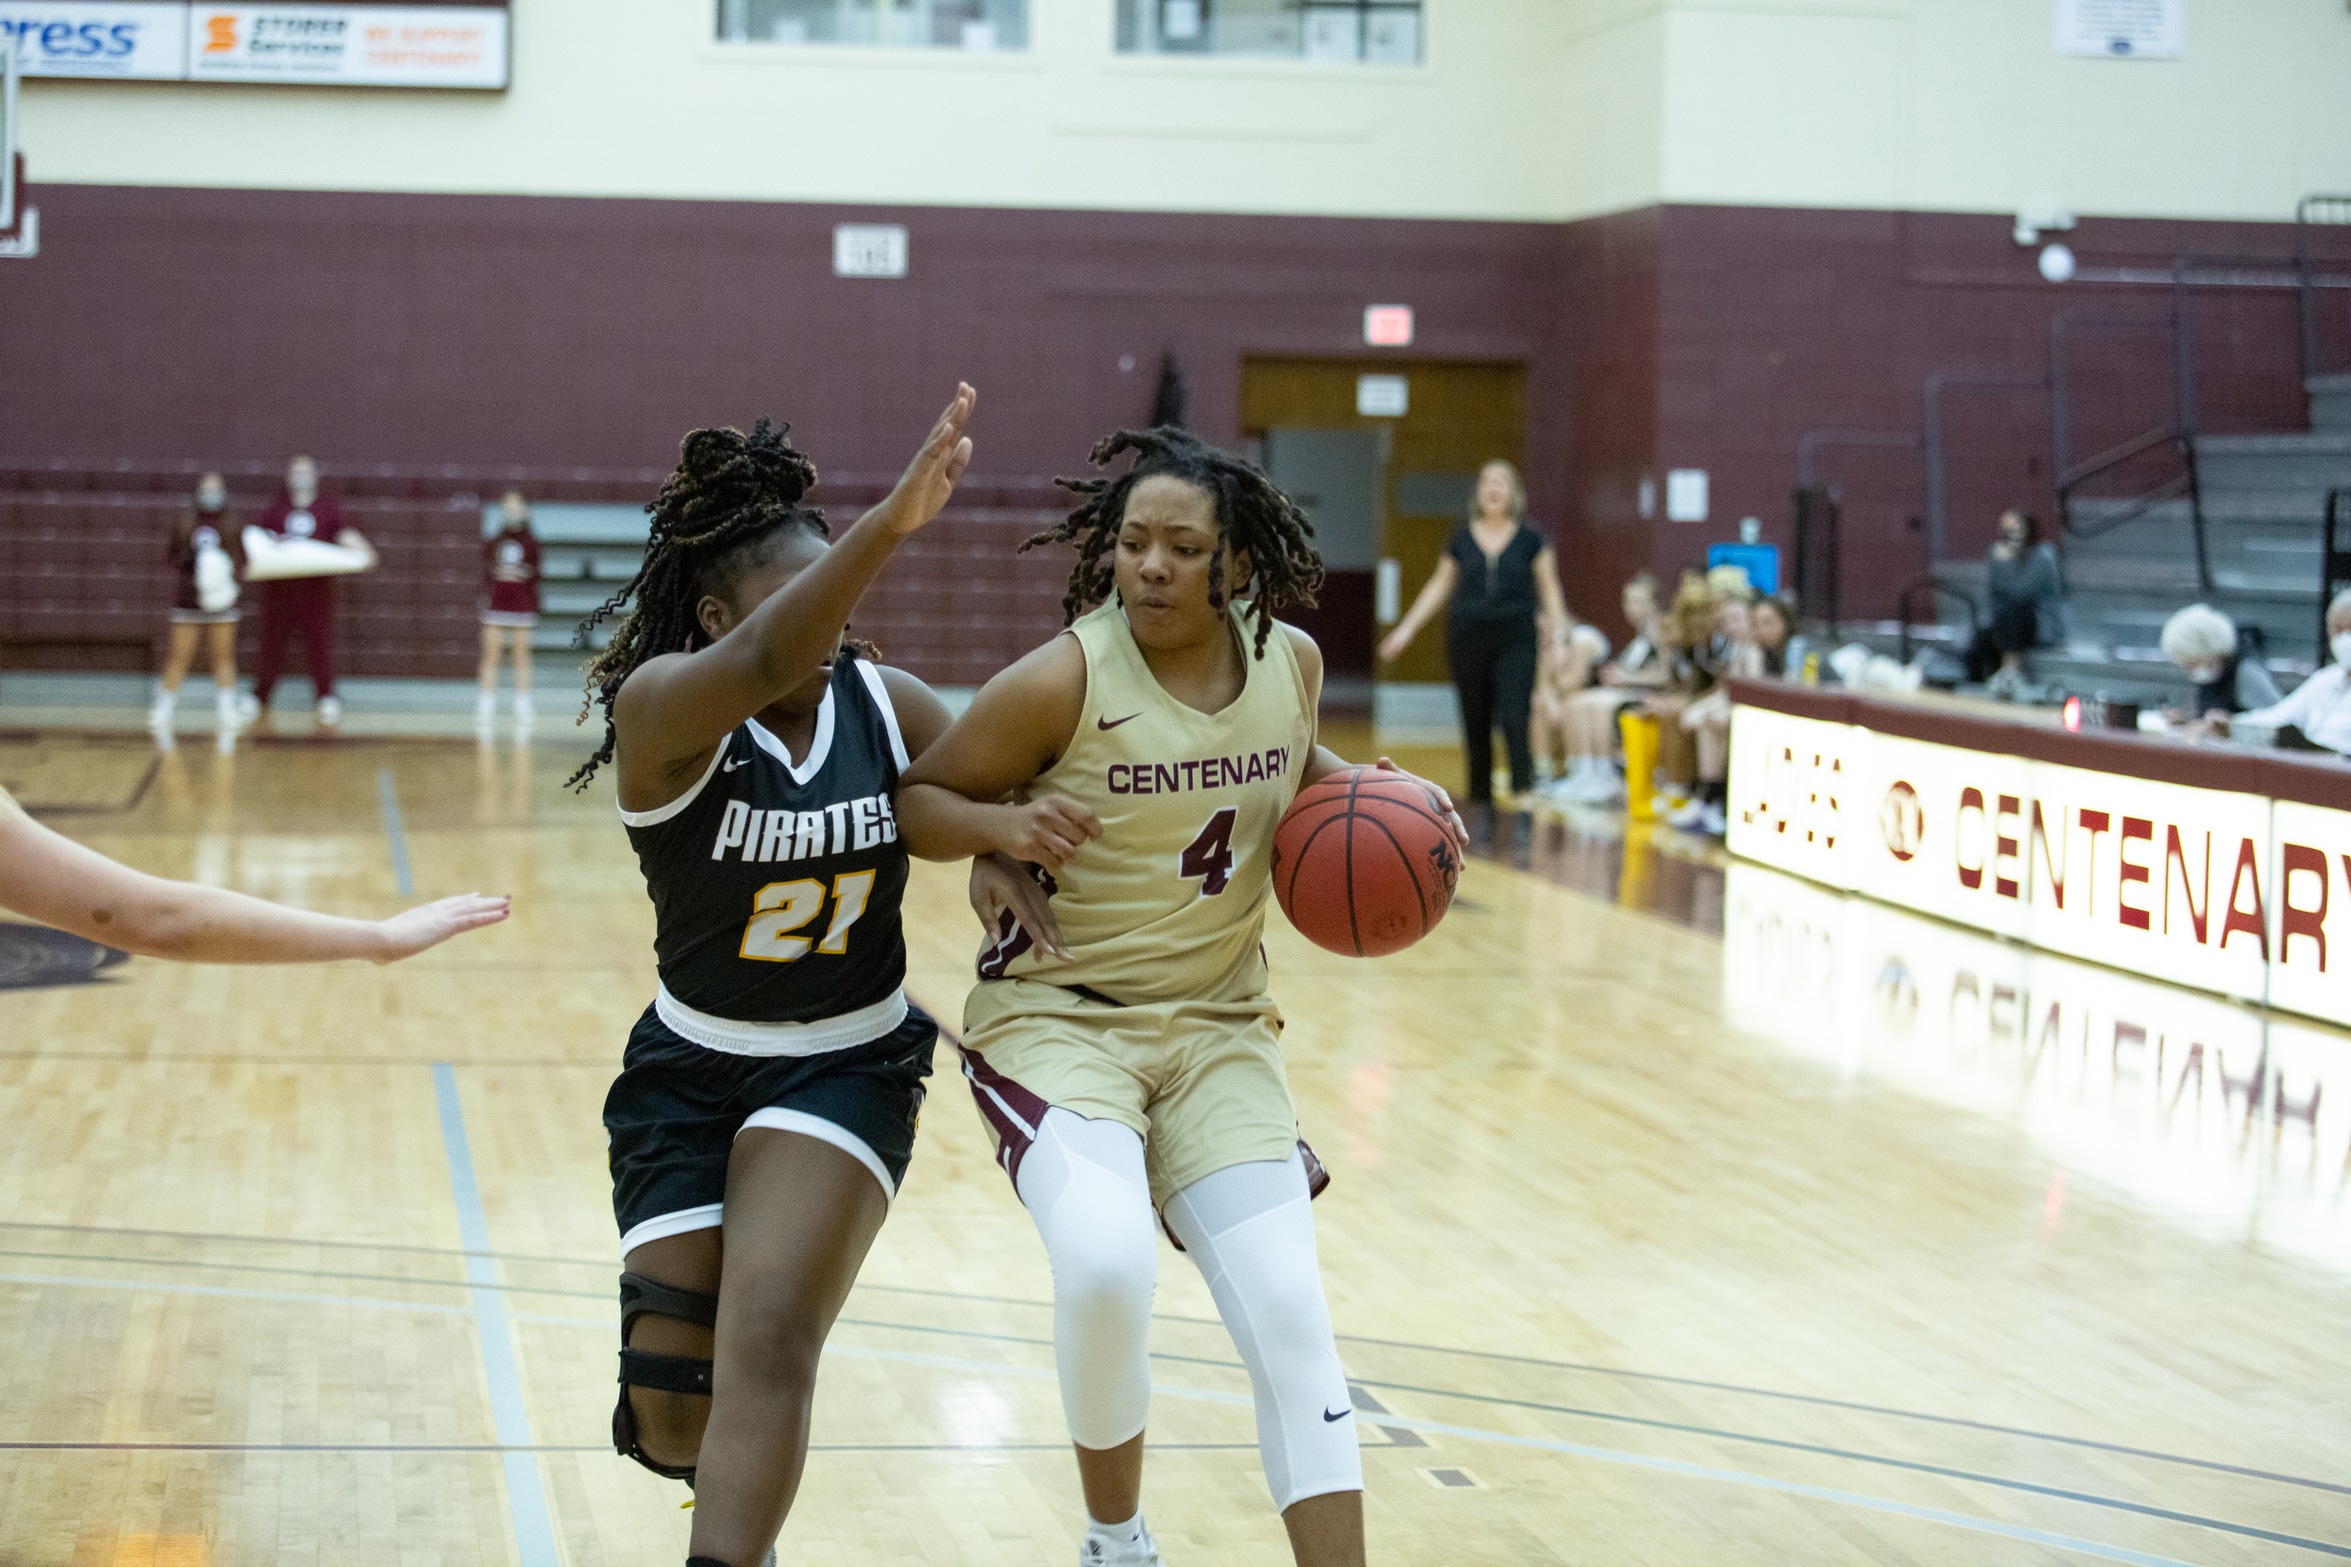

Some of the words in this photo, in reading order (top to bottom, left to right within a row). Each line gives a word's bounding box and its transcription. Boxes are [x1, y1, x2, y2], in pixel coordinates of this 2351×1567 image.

[1108, 745, 1290, 794] CENTENARY
[711, 792, 897, 863] PIRATES
[1177, 805, 1239, 900] 4
[739, 868, 877, 962] 21
[1957, 786, 2351, 973] CENTENAR
